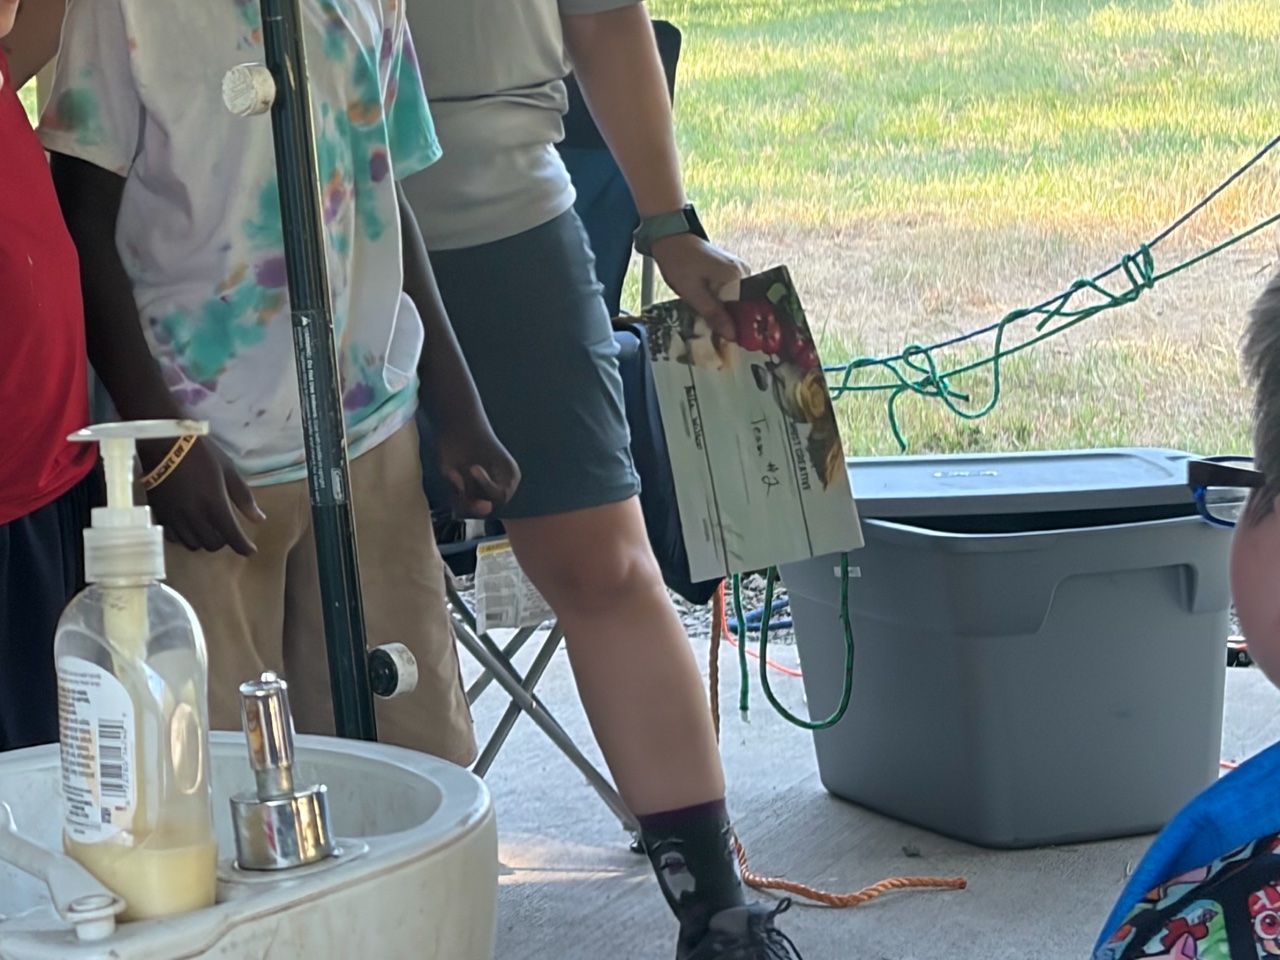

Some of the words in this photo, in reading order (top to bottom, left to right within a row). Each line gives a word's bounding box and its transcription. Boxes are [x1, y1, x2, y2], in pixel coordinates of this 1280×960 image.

[174, 444, 184, 458] OF
[751, 411, 770, 456] Team
[761, 462, 780, 497] #2
